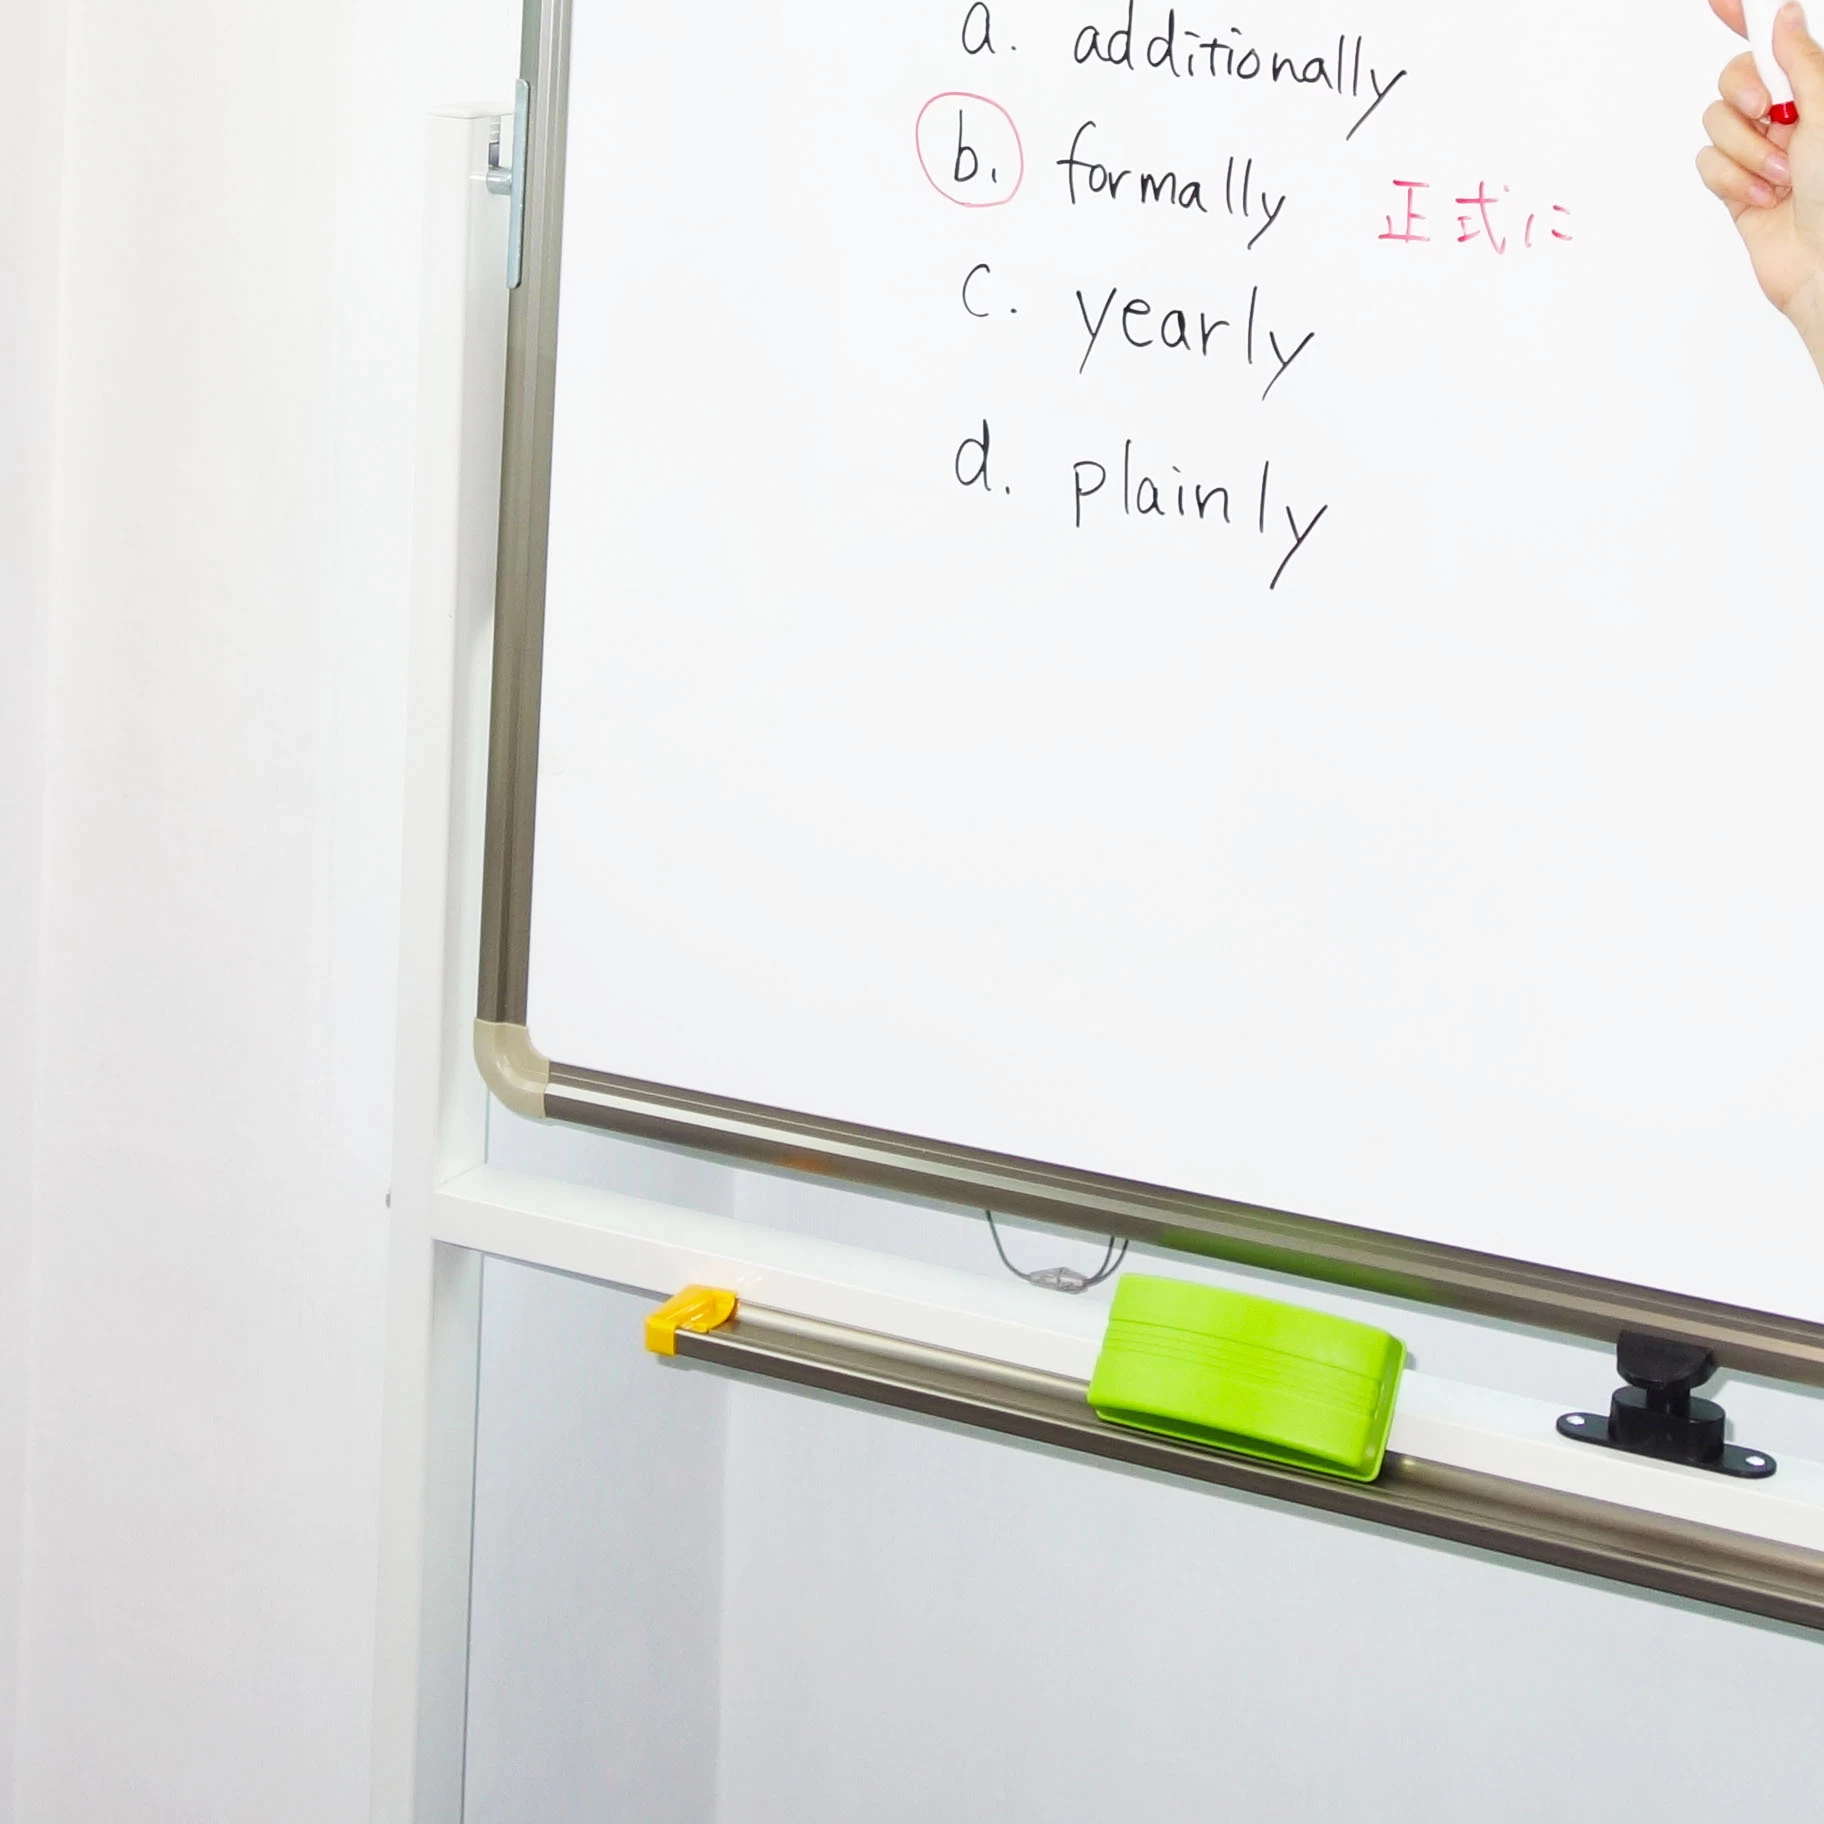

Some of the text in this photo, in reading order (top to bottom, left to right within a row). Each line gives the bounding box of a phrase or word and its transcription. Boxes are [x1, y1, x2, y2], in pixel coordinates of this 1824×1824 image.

[961, 1, 1017, 56] a.
[953, 109, 1287, 251] b. formally
[1377, 179, 1575, 255] 正式に
[961, 263, 1316, 401] c. yearly
[954, 418, 1329, 591] d. plainly
